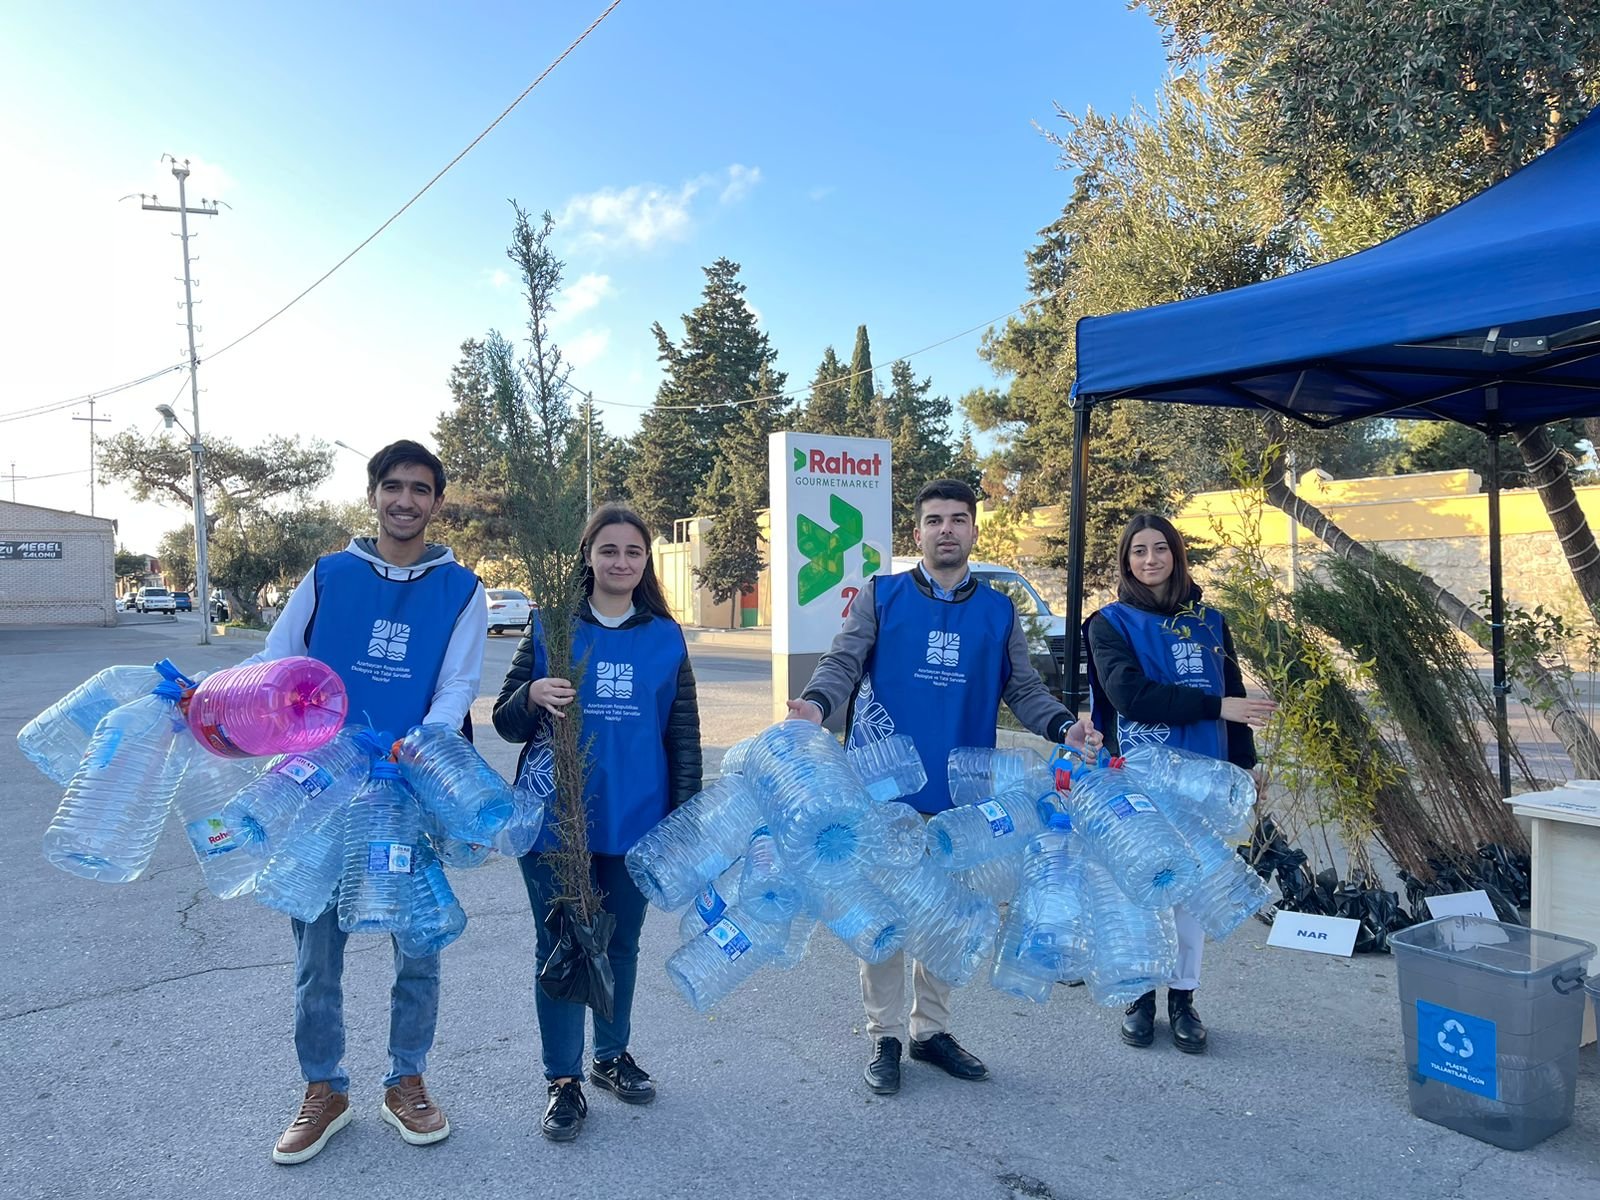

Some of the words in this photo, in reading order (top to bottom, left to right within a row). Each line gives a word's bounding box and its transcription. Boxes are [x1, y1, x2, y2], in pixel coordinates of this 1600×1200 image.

[809, 449, 882, 476] Rahat
[795, 477, 879, 489] GOURMETMARKET
[16, 542, 61, 552] MEBEL
[1296, 929, 1328, 940] NAR
